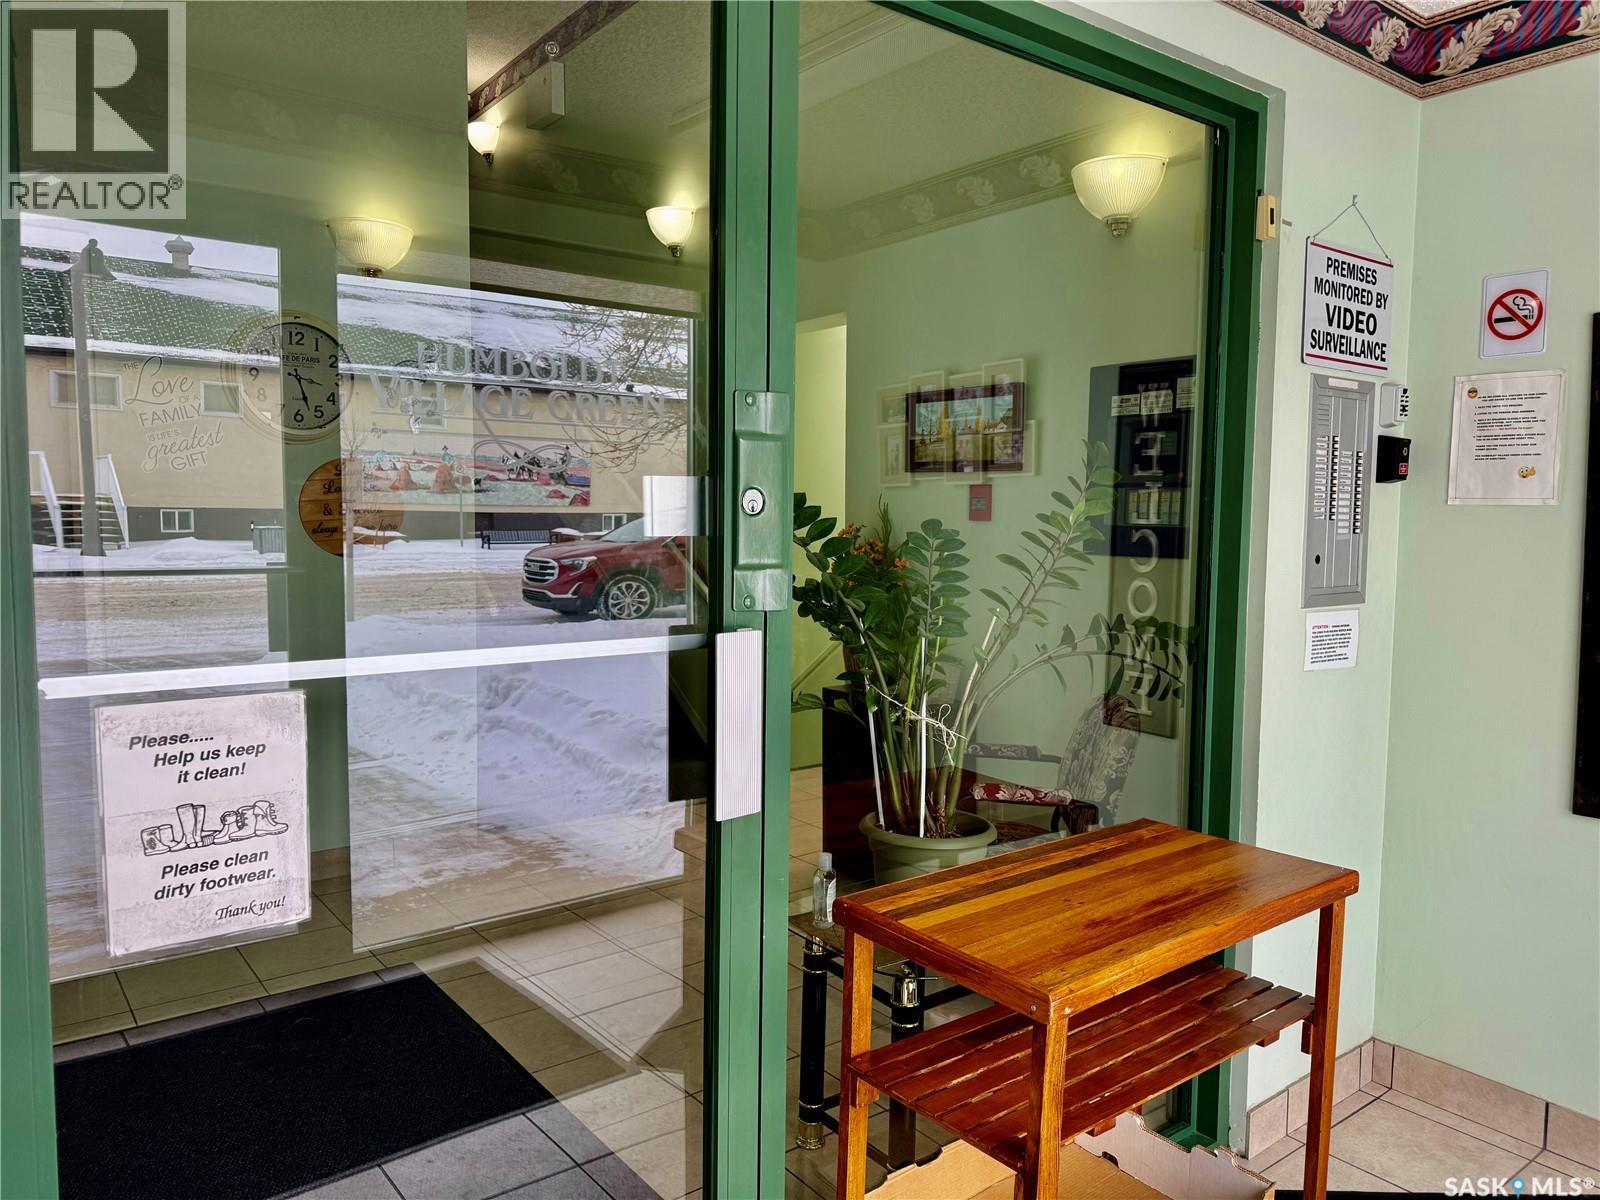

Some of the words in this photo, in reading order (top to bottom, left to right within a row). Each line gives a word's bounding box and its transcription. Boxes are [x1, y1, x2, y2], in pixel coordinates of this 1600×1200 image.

[1326, 256, 1377, 286] PREMISES
[1314, 276, 1373, 306] MONITORED
[1375, 292, 1389, 310] BY
[1325, 302, 1377, 336] VIDEO
[288, 330, 305, 346] 12
[1310, 328, 1387, 362] SURVEILLANCE
[123, 361, 139, 371] THE
[248, 367, 259, 381] 9
[328, 354, 338, 369] 2
[416, 341, 622, 386] HUMBOLDT
[124, 355, 195, 406] Love
[256, 387, 267, 402] 8
[326, 391, 336, 406] 4
[369, 375, 535, 420] VILLAGE
[548, 389, 666, 430] GREEN
[138, 402, 202, 427] FAMILY
[293, 408, 304, 423] 6
[314, 404, 324, 419] 5
[143, 421, 224, 473] greatest
[170, 450, 208, 471] GIFT
[311, 521, 339, 538] always
[153, 751, 194, 768] Help
[199, 747, 221, 762] us
[225, 742, 266, 760] keep
[177, 768, 189, 784] it
[193, 762, 246, 782] clean!
[160, 858, 219, 880] Please
[224, 850, 269, 868] clean
[154, 879, 194, 900] dirty
[199, 867, 276, 893] footwear.
[215, 901, 257, 920] Thank
[254, 895, 286, 914] you!
